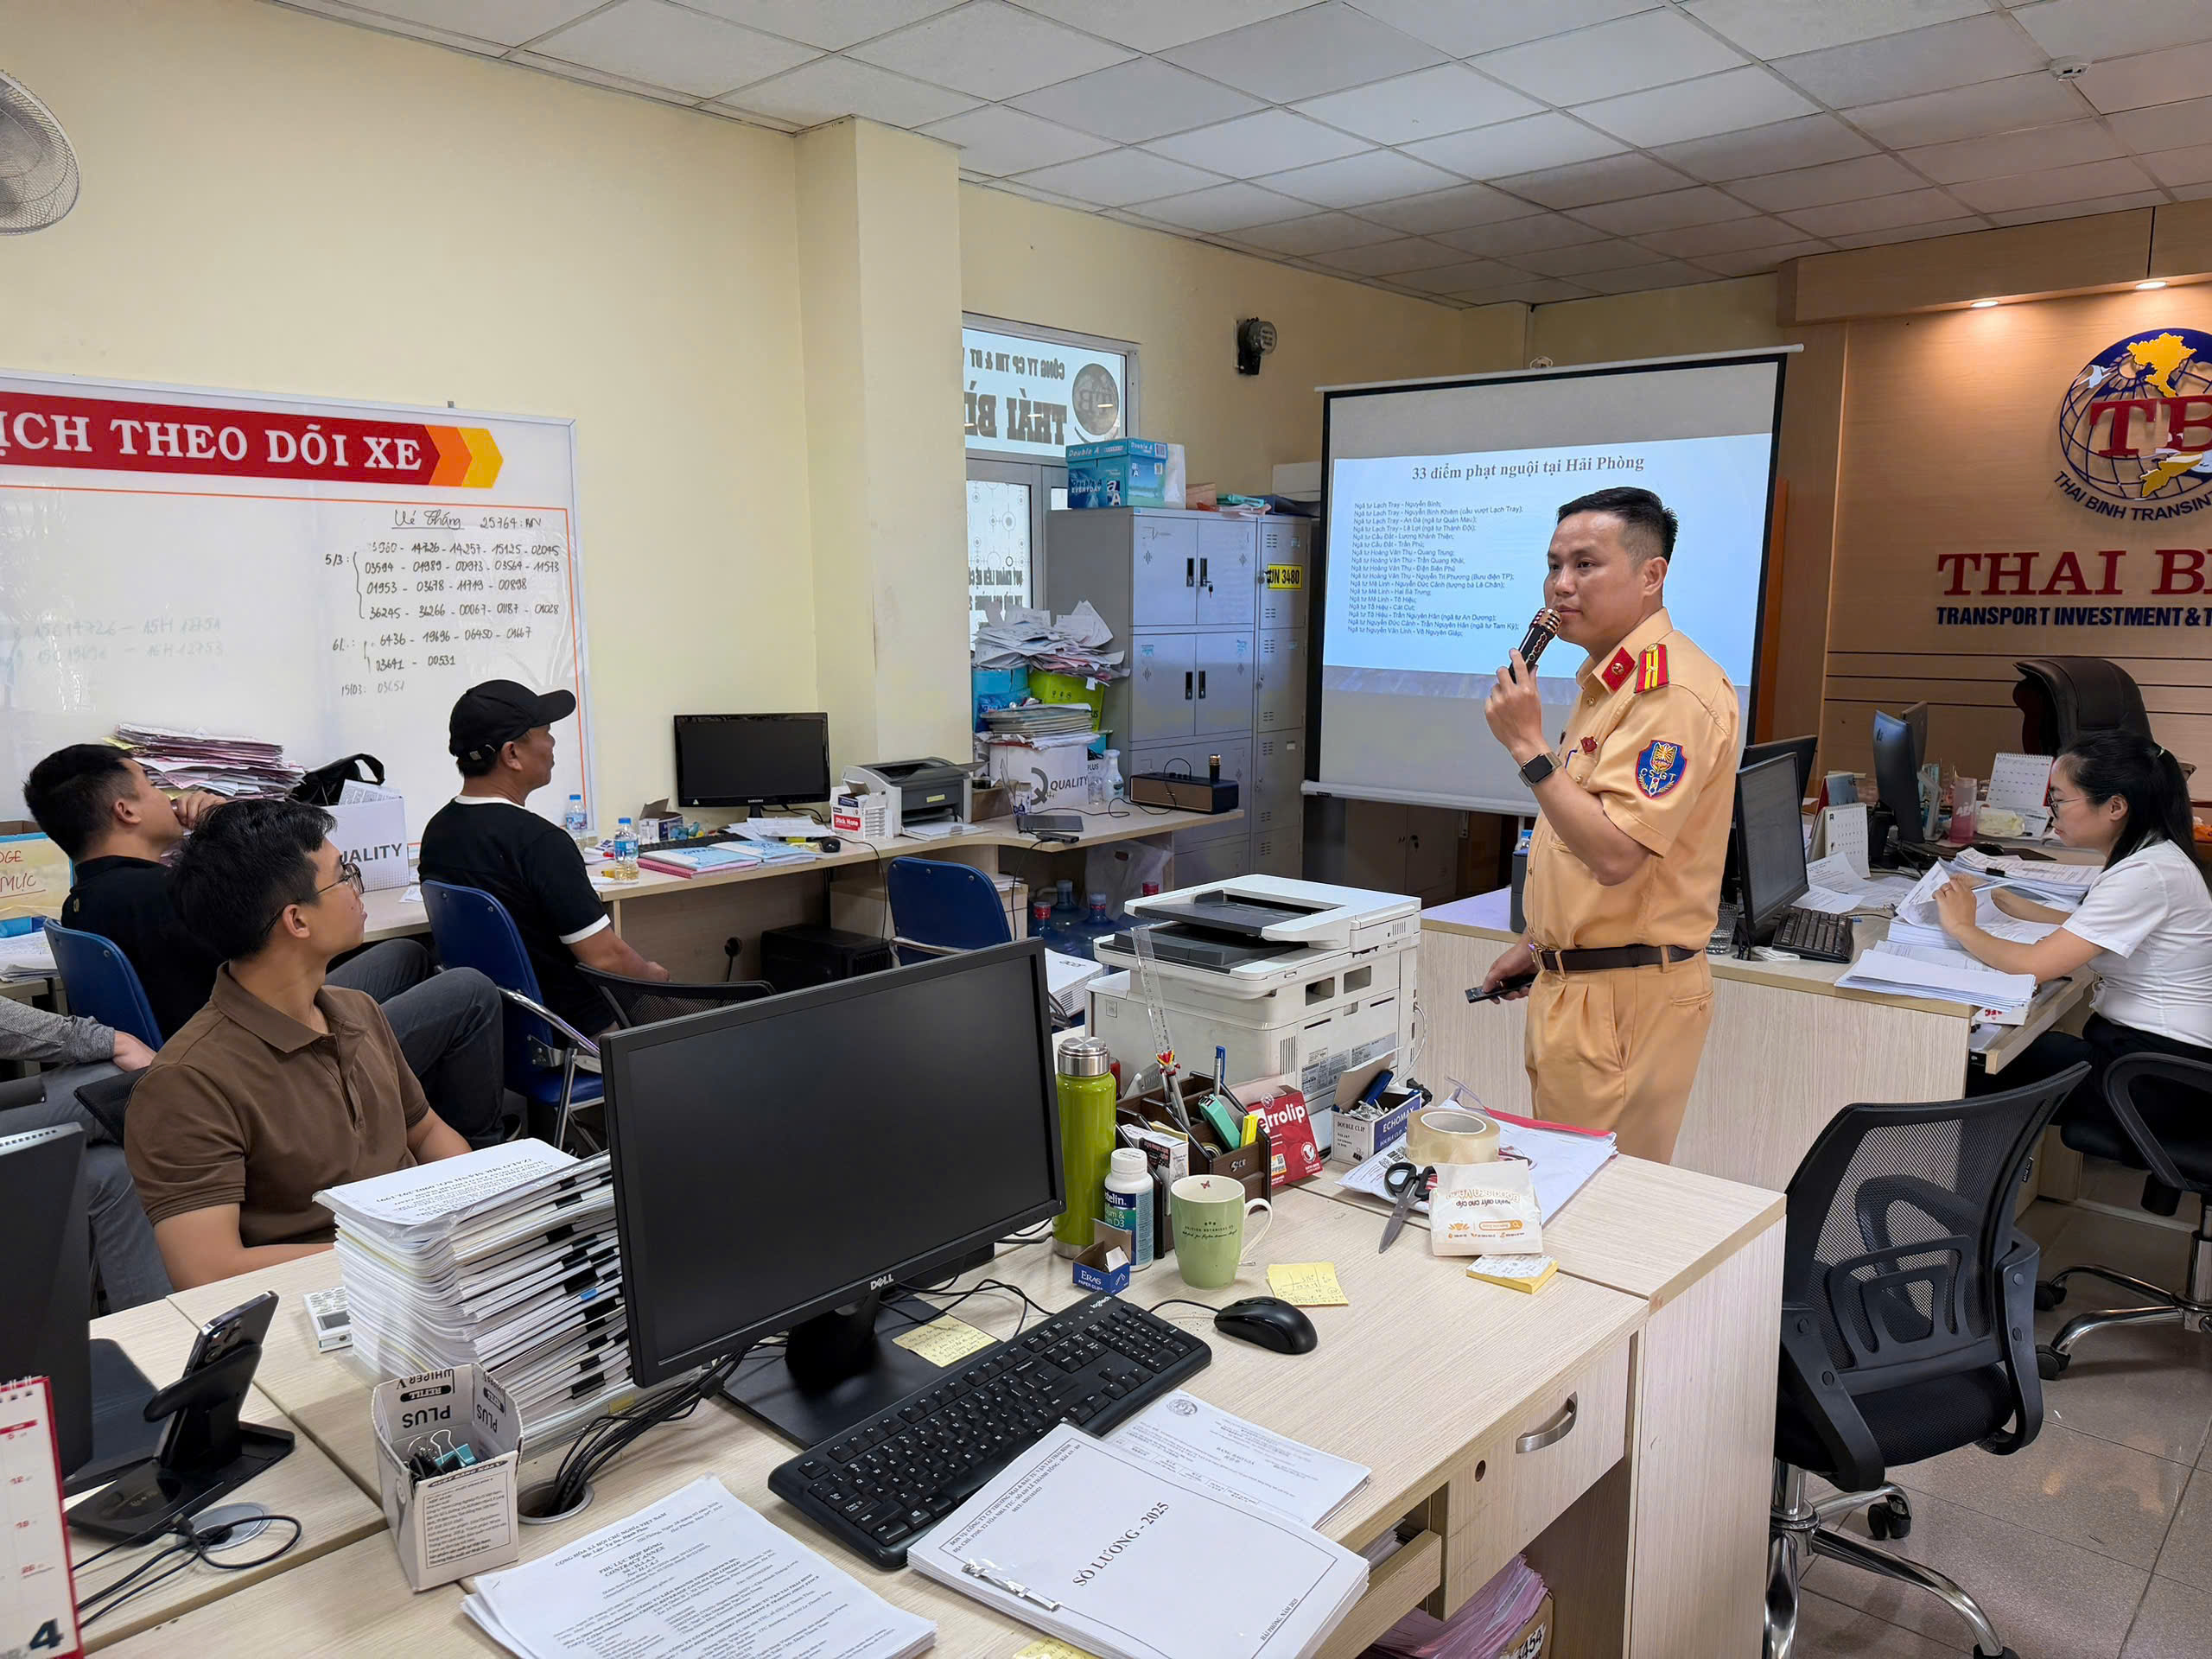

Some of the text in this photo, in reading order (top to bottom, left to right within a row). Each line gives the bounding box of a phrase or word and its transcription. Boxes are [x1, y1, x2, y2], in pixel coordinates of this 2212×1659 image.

[110, 418, 248, 462] THEO
[265, 423, 349, 467] DÕI
[364, 435, 422, 471] XE
[1412, 456, 1645, 480] 33 điểm phạt nguội tại Hải Phòng
[2054, 471, 2212, 521] THAI BINH TRANSIN
[1281, 569, 1300, 584] 3480
[1936, 549, 2212, 596] THAI B
[1936, 607, 2050, 626] TRANSPORT
[2054, 607, 2183, 626] INVESTMENT
[2183, 607, 2201, 626] &
[1050, 775, 1088, 792] QUALITY
[1257, 1103, 1306, 1128] errolip
[1337, 1121, 1354, 1130] DOUBLE
[870, 1274, 894, 1291] DELL
[1081, 1269, 1102, 1285] ERAS
[396, 1368, 454, 1389] WHIPER V
[409, 1386, 442, 1400] REFILL
[402, 1405, 451, 1428] PLUS
[477, 1403, 498, 1433] PLUS
[1092, 1526, 1141, 1573] LƯƠNG
[1141, 1500, 1171, 1526] 2025
[29, 1618, 65, 1650] 4
